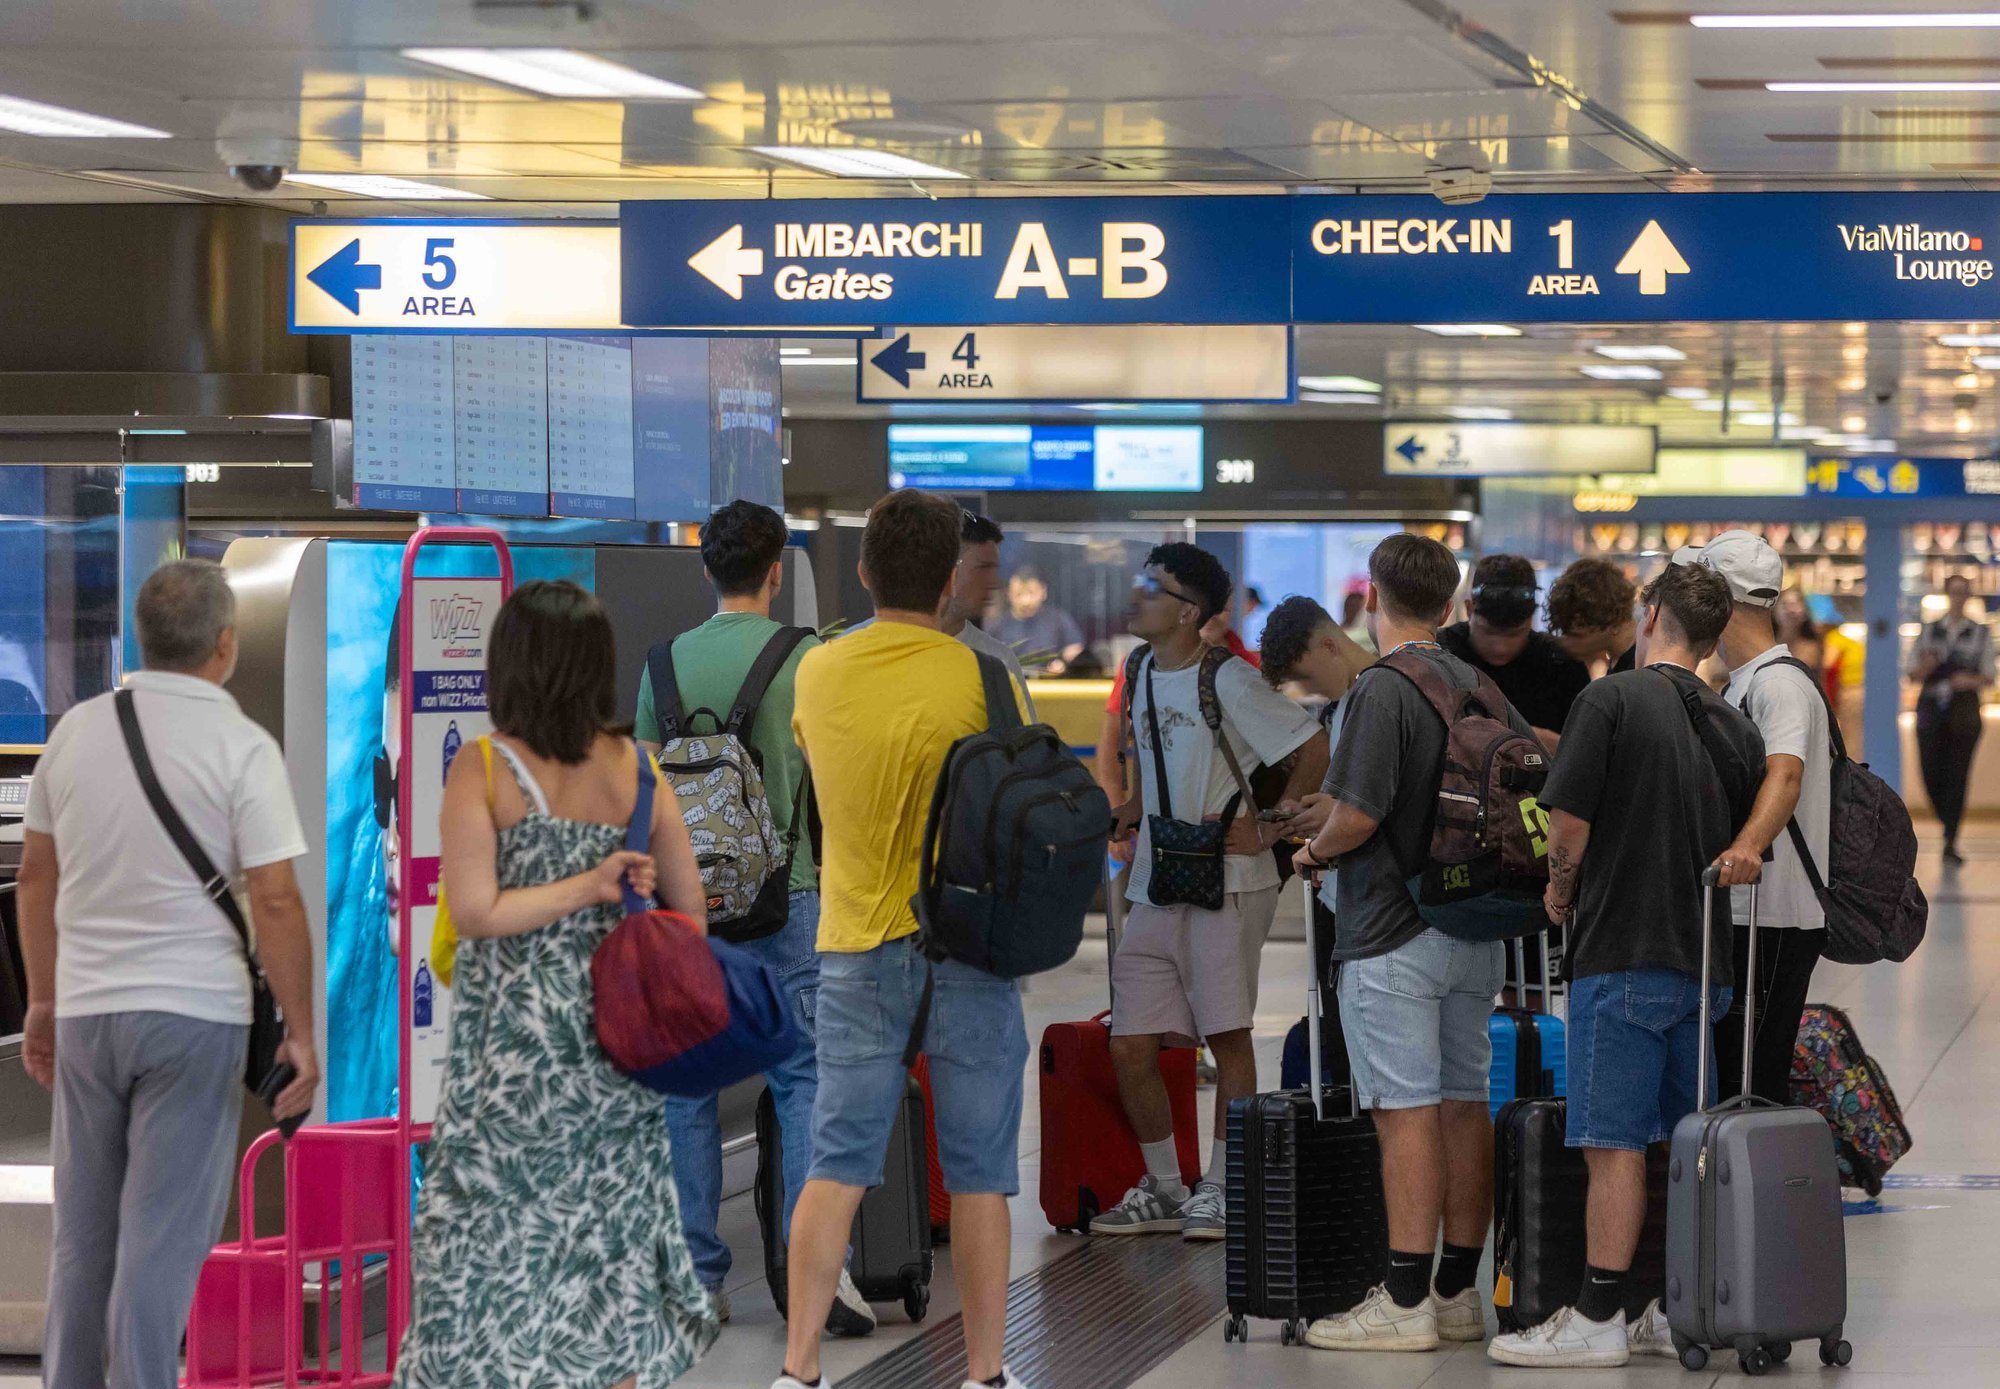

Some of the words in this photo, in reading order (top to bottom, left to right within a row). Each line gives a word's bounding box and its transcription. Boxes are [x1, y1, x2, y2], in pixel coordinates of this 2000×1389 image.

[774, 222, 982, 258] IMBARCHI
[1311, 218, 1512, 255] CHECK-IN
[1548, 219, 1573, 269] 1
[1837, 223, 1970, 251] ViaMilano
[421, 237, 457, 291] 5
[995, 222, 1168, 299] A-B
[1893, 252, 1994, 287] Lounge
[774, 264, 894, 301] Gates
[1527, 275, 1601, 295] AREA
[402, 296, 476, 316] AREA
[951, 332, 980, 370] 4
[938, 373, 994, 389] AREA
[438, 675, 456, 690] BAG
[457, 675, 482, 689] ONLY
[421, 695, 438, 708] non
[438, 693, 462, 708] WIZZ
